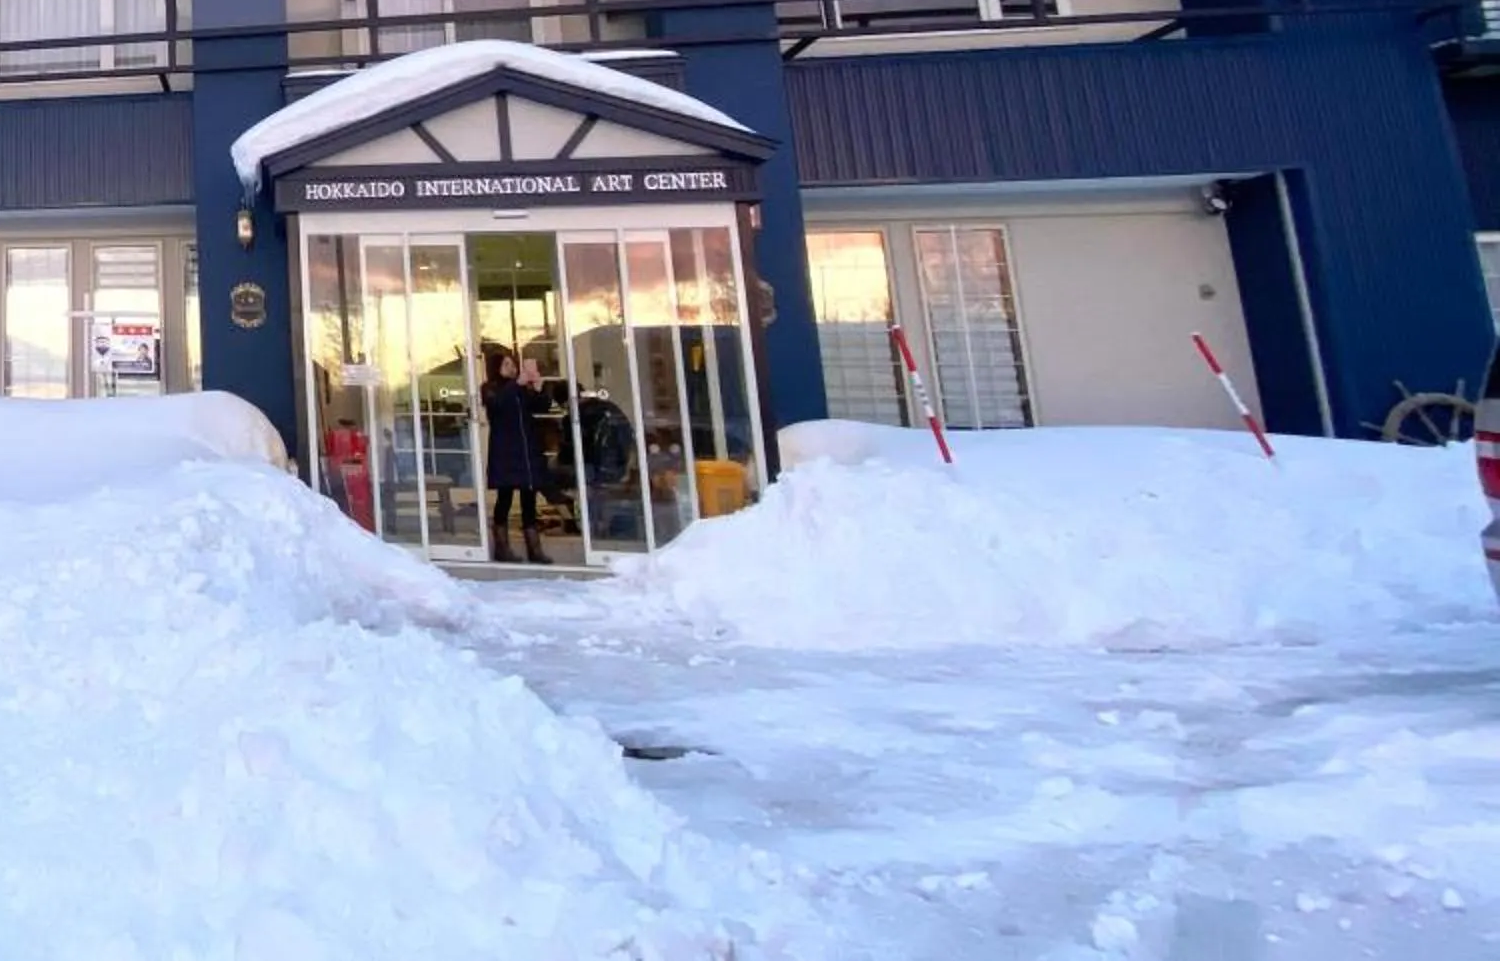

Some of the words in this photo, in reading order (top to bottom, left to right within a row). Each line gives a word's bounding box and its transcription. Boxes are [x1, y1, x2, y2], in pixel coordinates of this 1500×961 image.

[305, 180, 405, 200] HOKKAIDO
[415, 175, 581, 196] INTERNATIONAL
[591, 174, 633, 192] ART
[644, 171, 727, 190] CENTER
